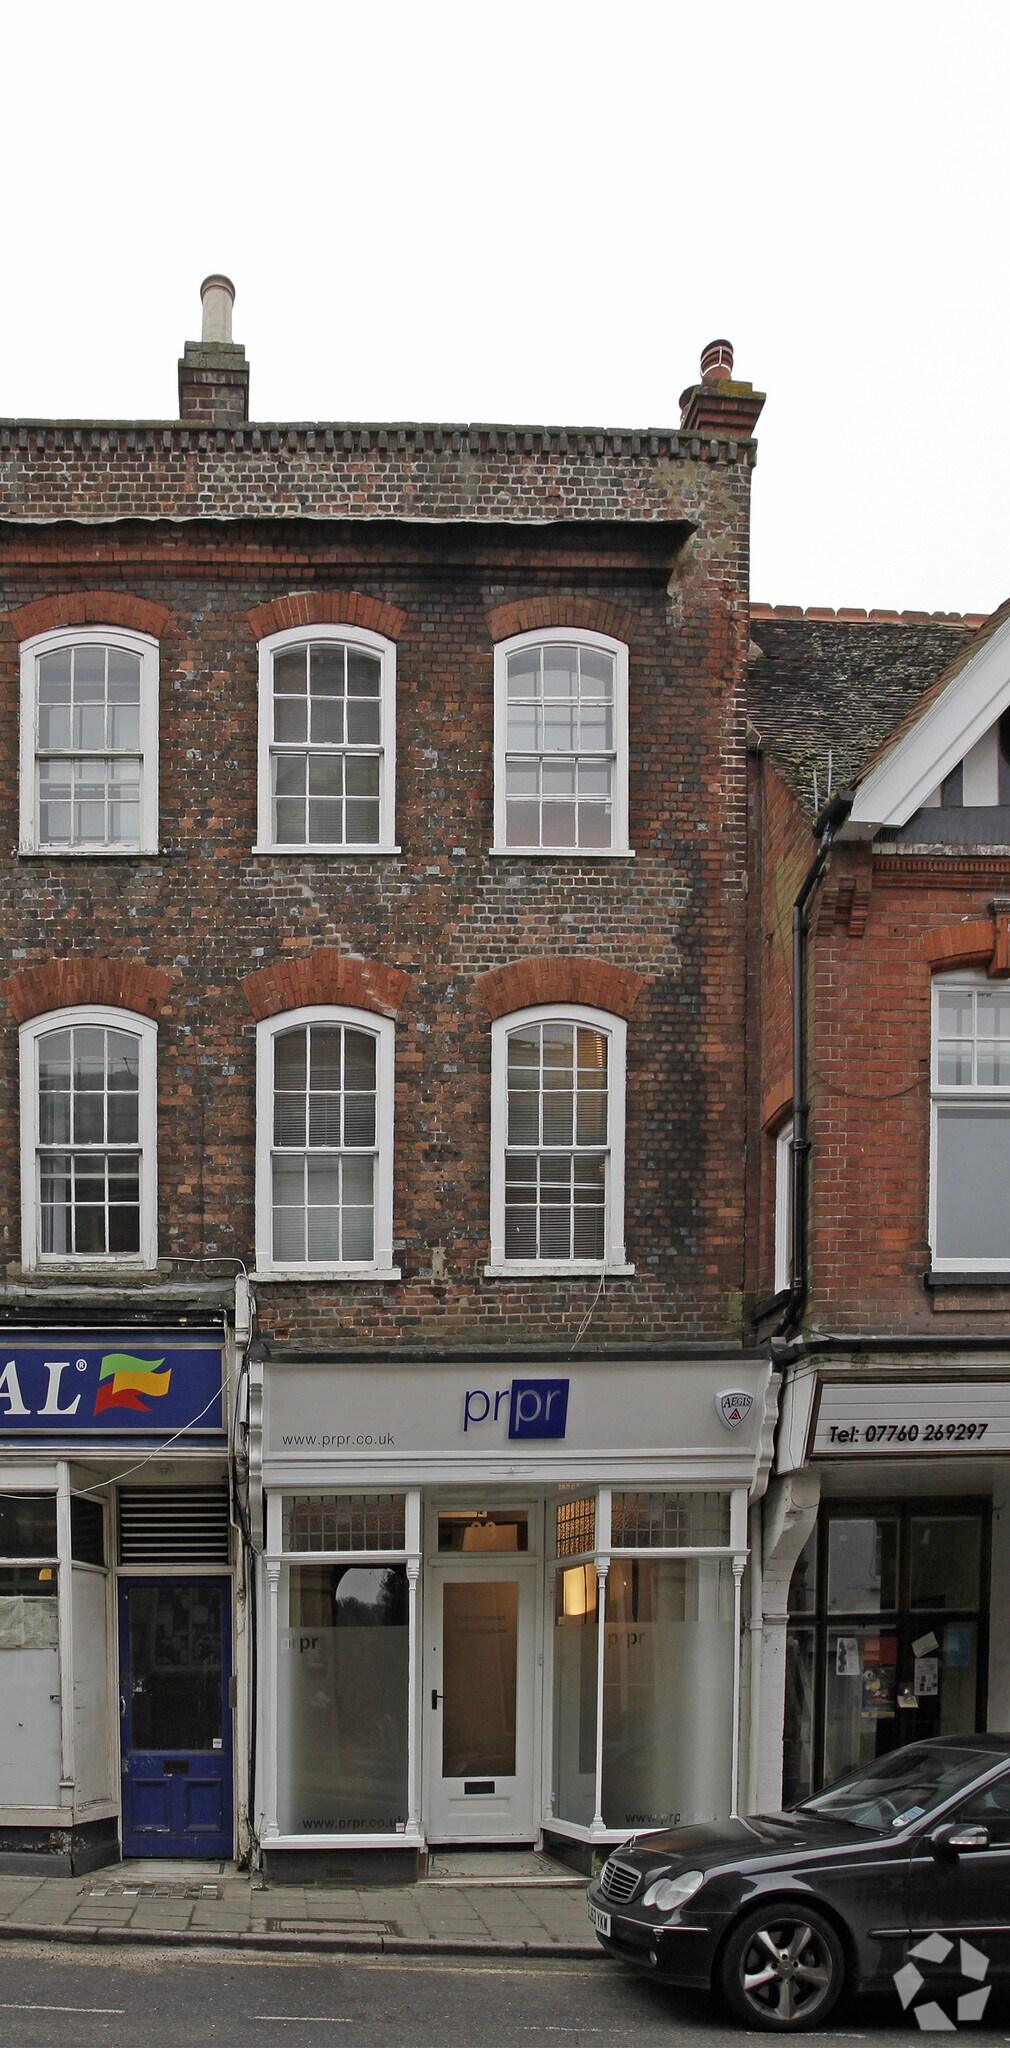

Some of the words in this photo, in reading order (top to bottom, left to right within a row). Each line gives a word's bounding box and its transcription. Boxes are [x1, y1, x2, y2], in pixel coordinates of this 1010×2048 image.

[723, 1396, 751, 1408] AEGIS
[282, 1432, 395, 1447] www.prpr.co.uk
[830, 1426, 859, 1443] Tel:
[865, 1424, 919, 1442] 07760
[922, 1423, 988, 1441] 269297
[608, 1632, 645, 1649] ppr
